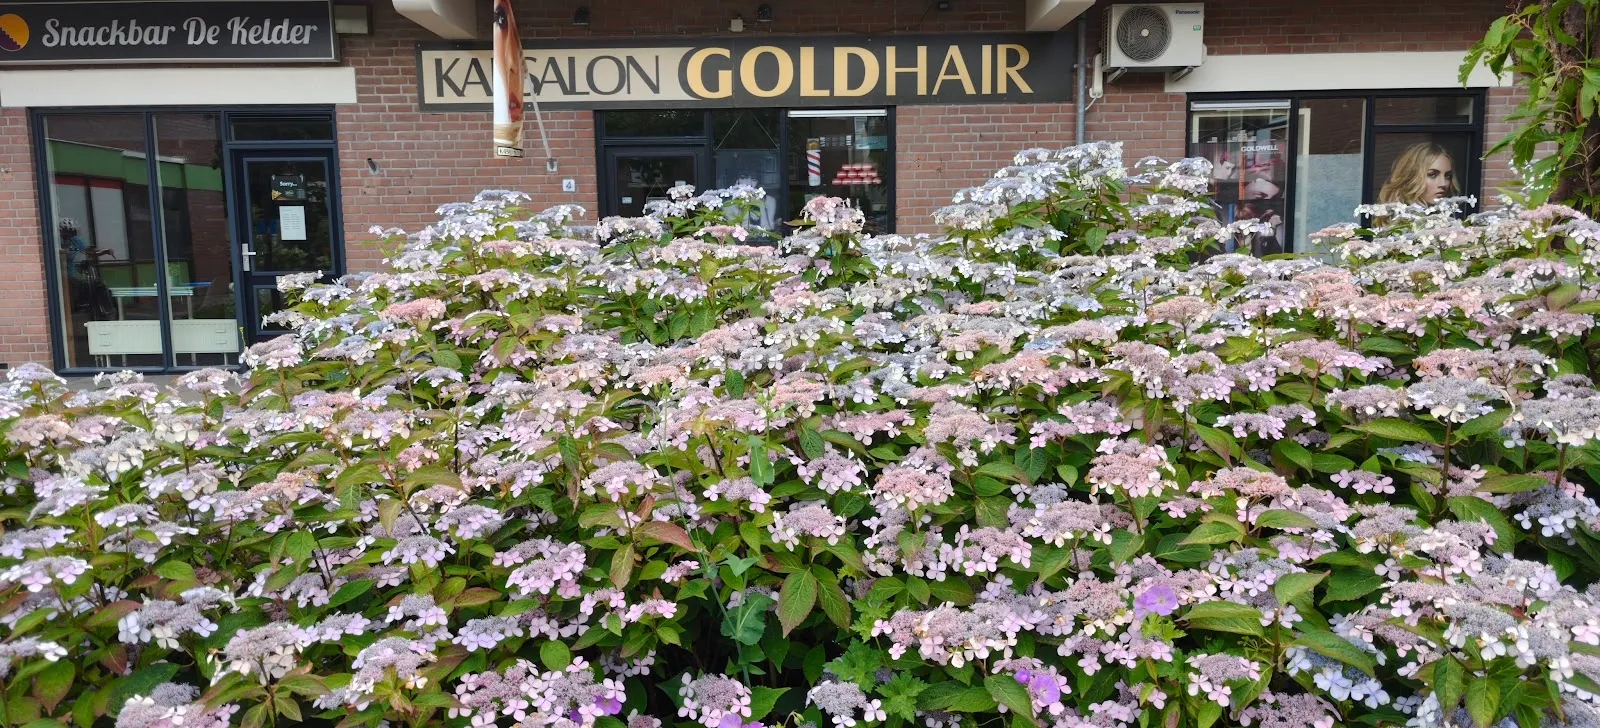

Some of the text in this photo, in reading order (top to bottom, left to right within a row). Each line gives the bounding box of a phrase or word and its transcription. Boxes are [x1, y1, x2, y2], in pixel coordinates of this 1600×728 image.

[42, 16, 318, 47] Snackbar De Kelder
[434, 43, 1034, 99] KASALON GOLDHAIR
